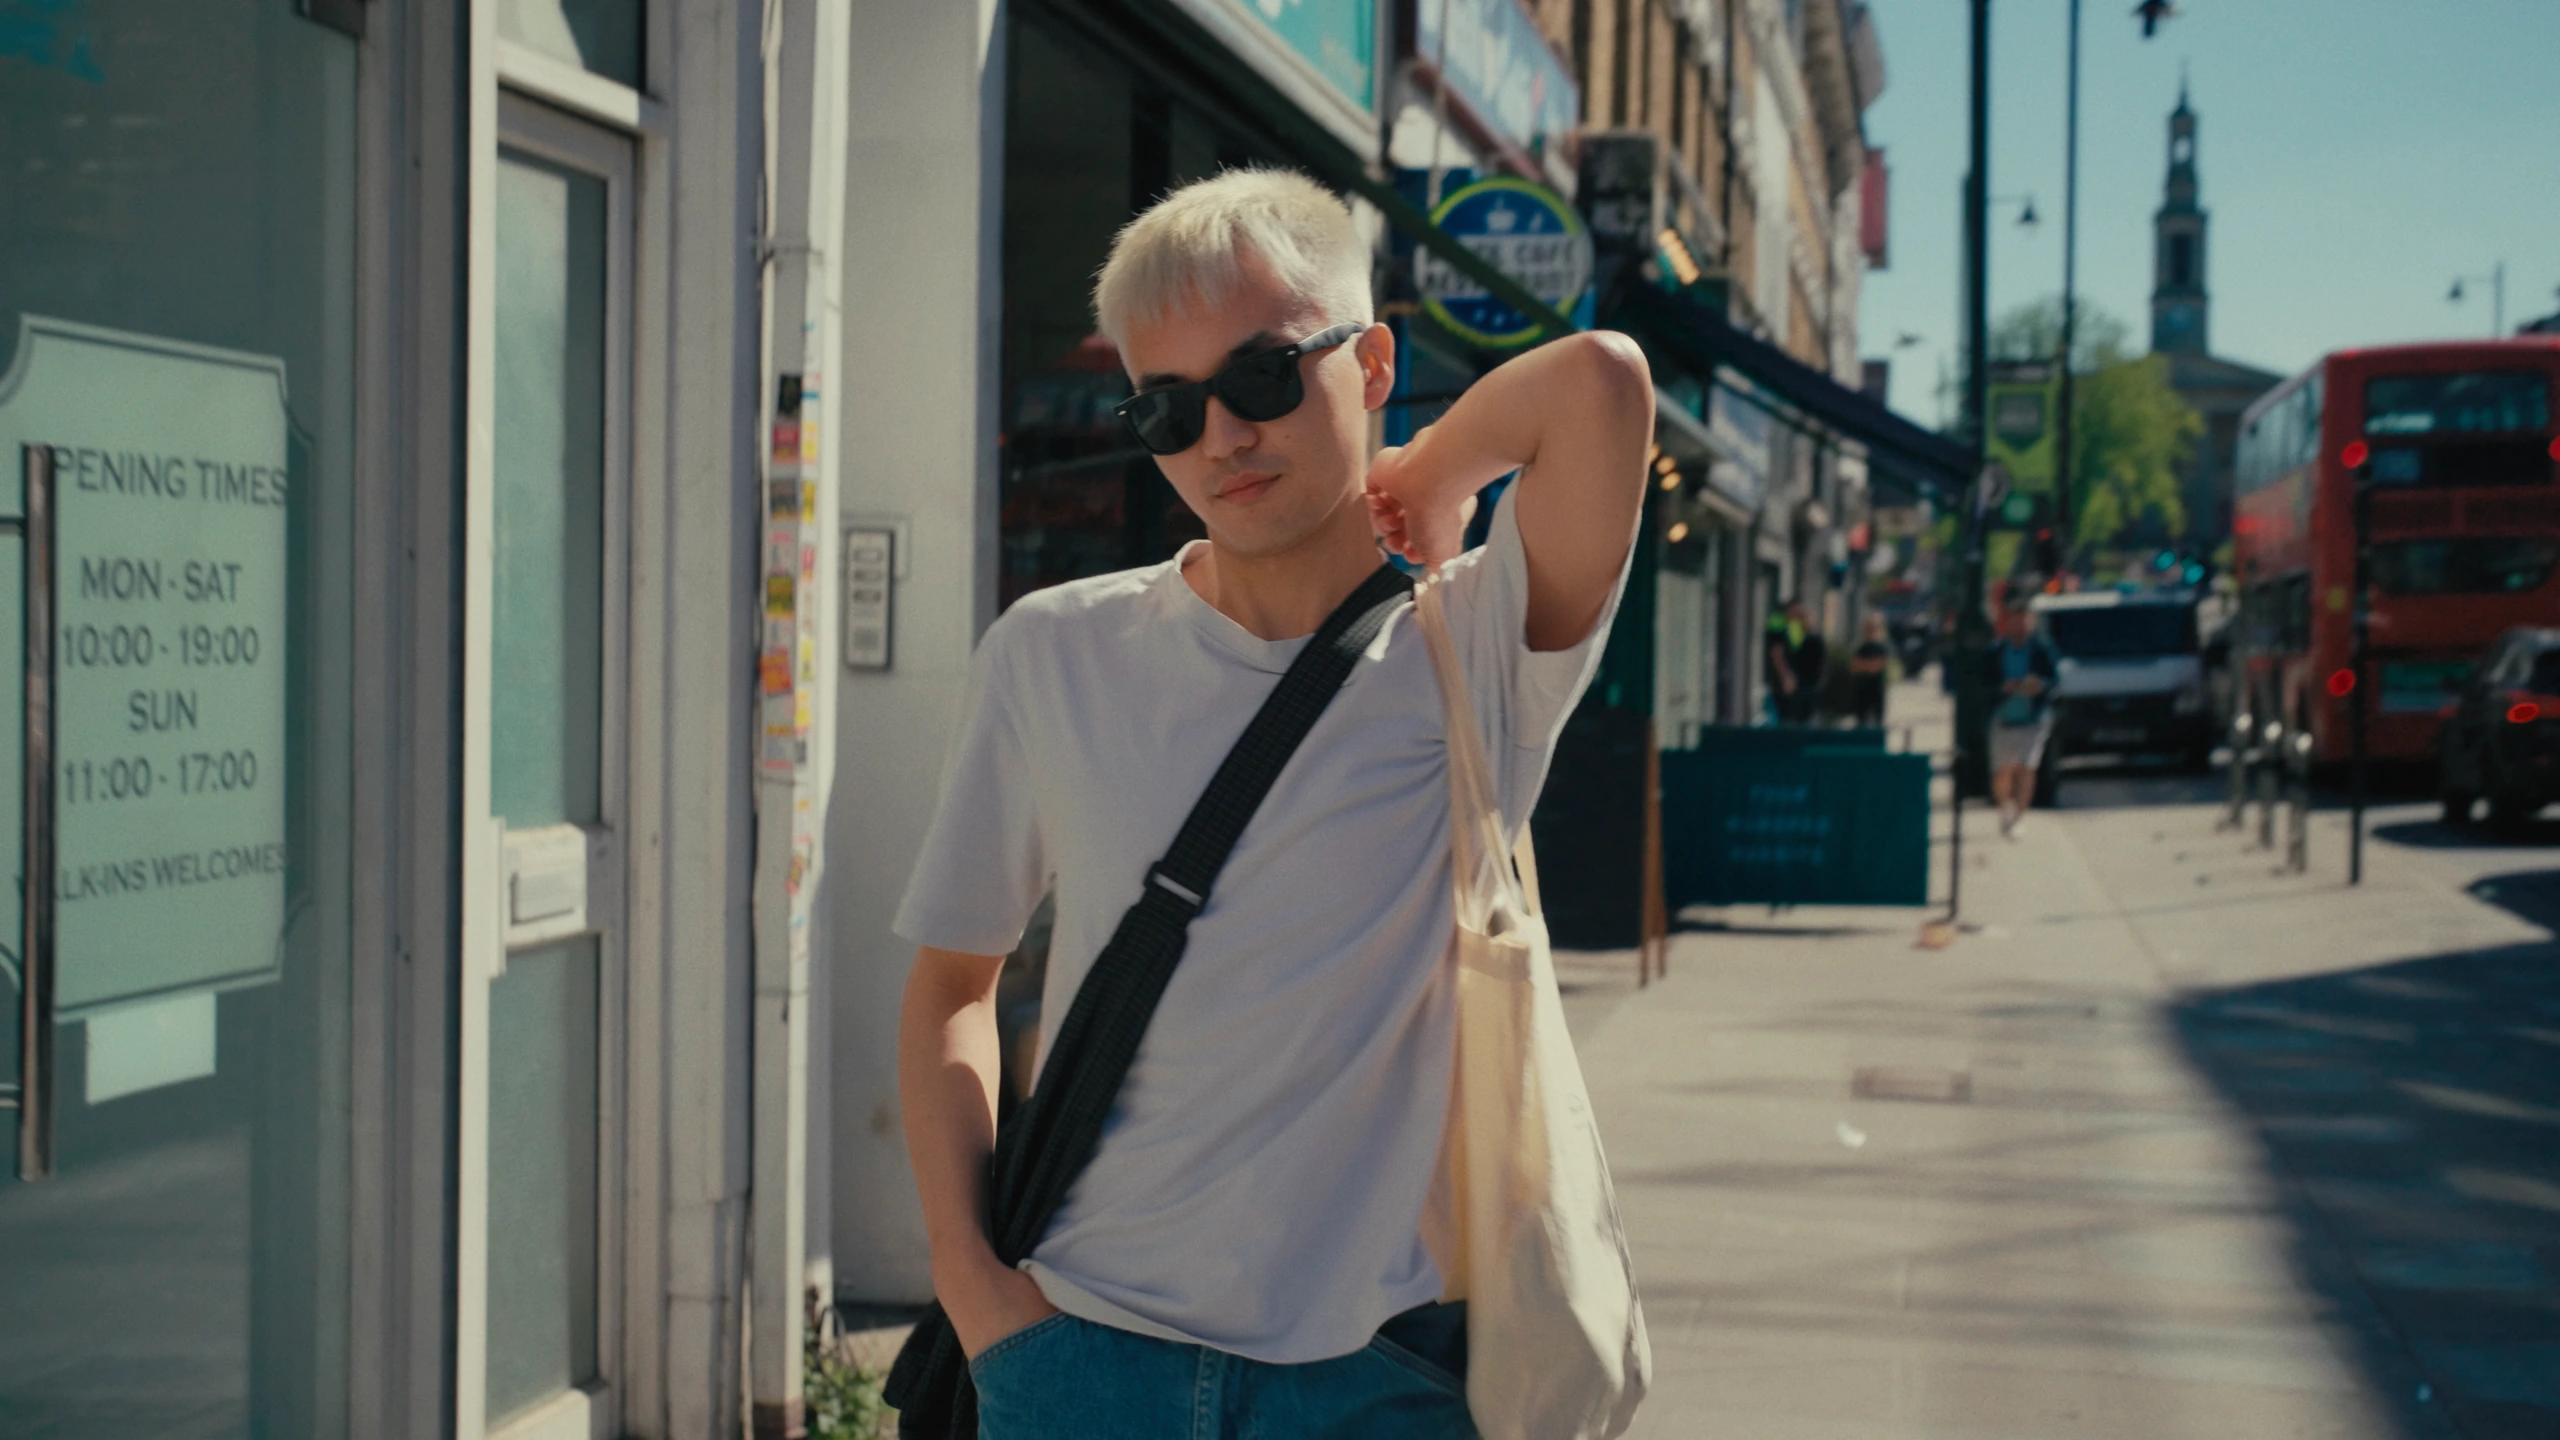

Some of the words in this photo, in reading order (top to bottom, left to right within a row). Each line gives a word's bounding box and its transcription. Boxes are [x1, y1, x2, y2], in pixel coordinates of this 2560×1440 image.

[52, 445, 187, 500] PENING
[194, 457, 289, 507] TIMES
[80, 554, 162, 601] MON
[183, 560, 243, 602] SAT
[62, 623, 153, 668] 10:00
[179, 624, 260, 667] 19:00
[128, 688, 198, 733] SUN
[63, 755, 152, 804] 11:00
[178, 749, 258, 795] 17:00
[14, 858, 147, 902] LK-INS
